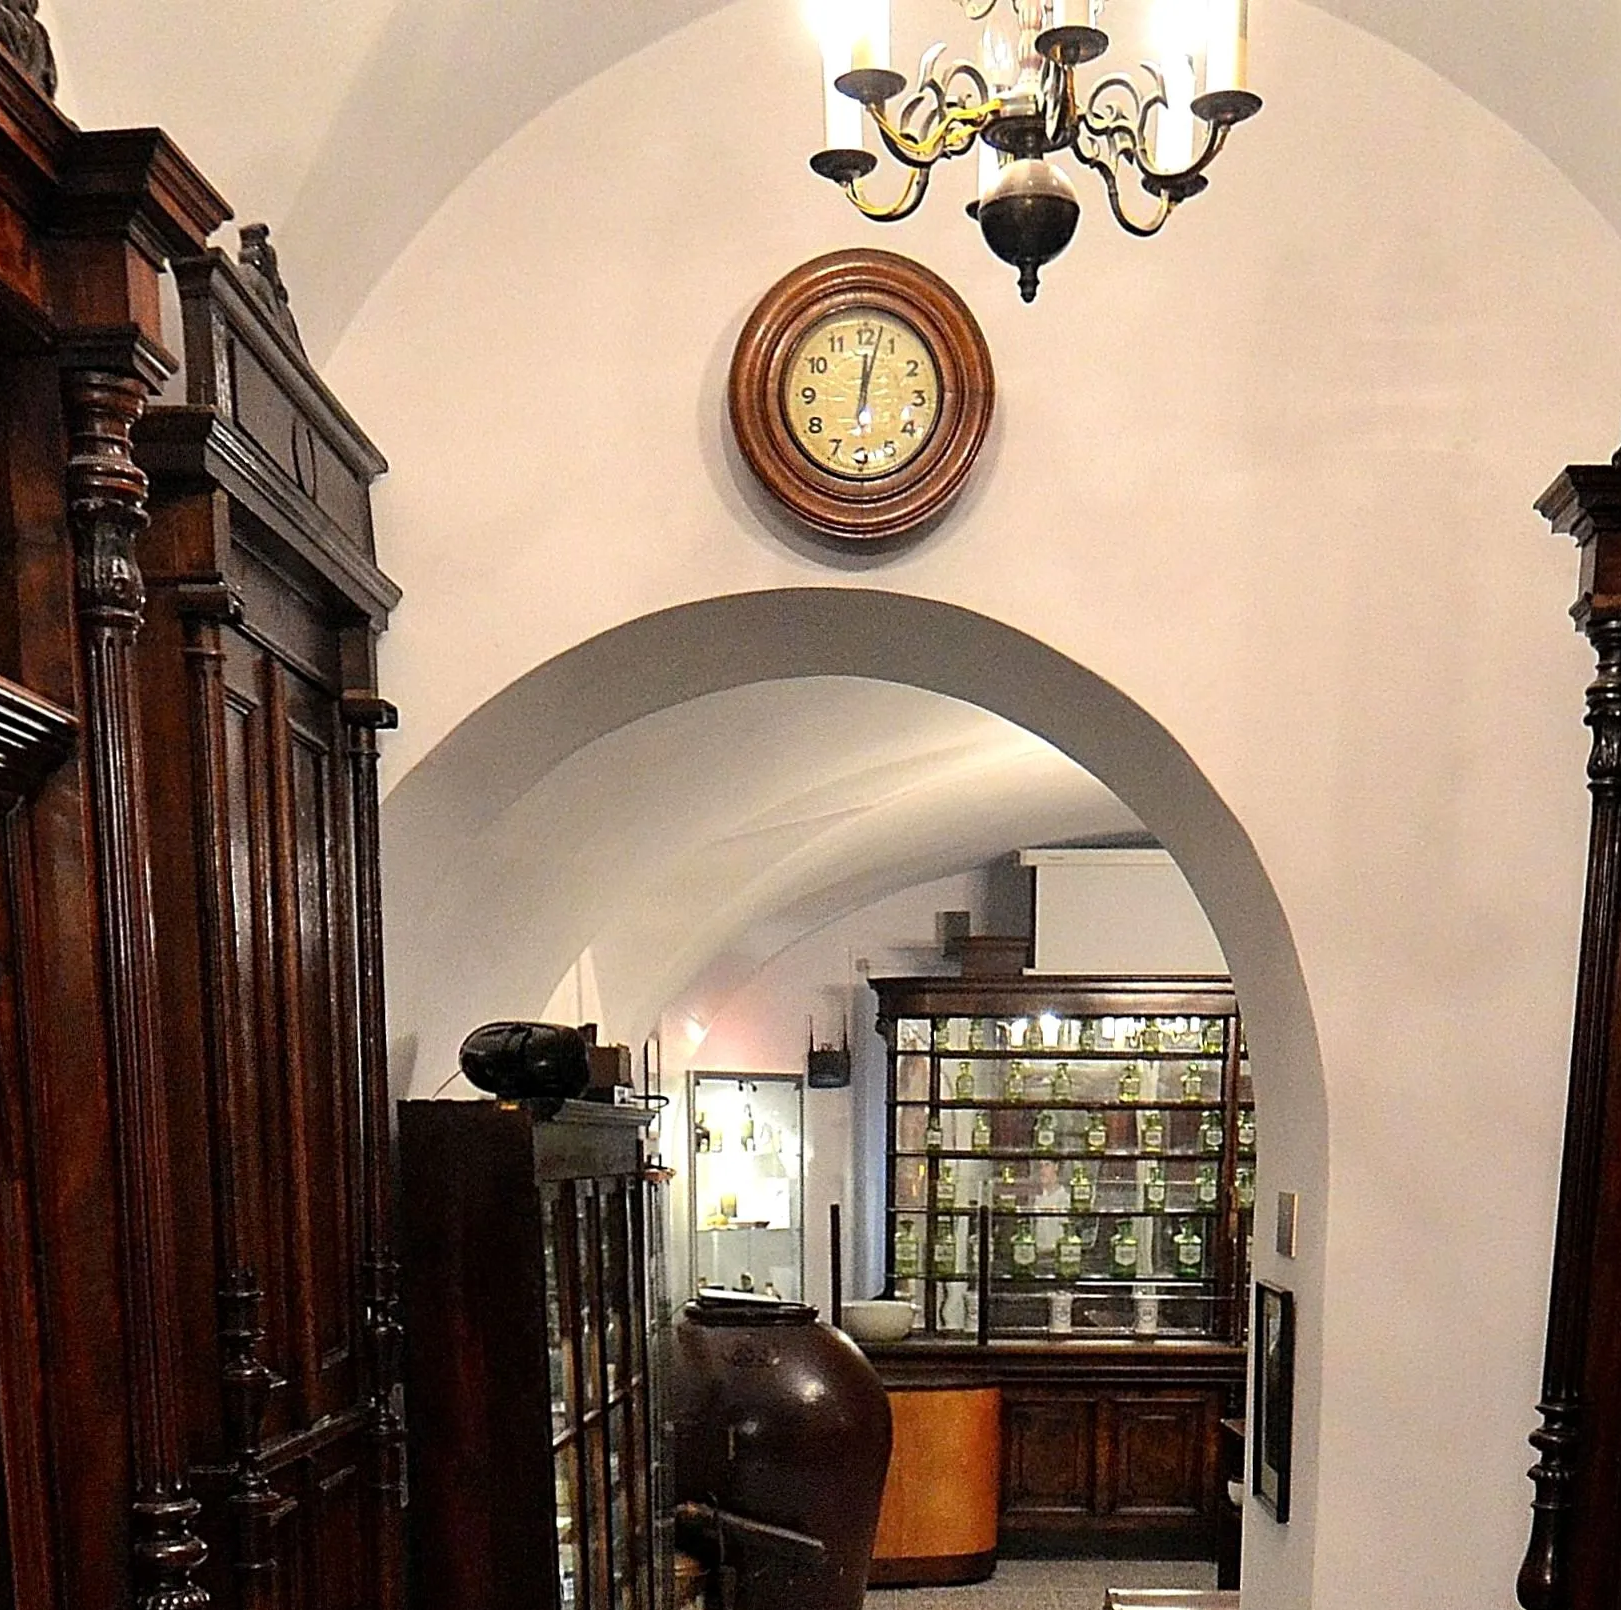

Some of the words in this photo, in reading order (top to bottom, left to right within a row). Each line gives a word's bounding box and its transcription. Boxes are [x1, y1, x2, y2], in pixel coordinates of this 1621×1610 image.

[828, 335, 844, 353] 11
[857, 328, 874, 346] 12
[888, 338, 895, 353] 1
[808, 357, 827, 374] 10
[906, 360, 918, 377] 2
[802, 388, 816, 404] 9
[912, 390, 926, 406] 3
[808, 417, 822, 434] 8
[901, 421, 916, 436] 4
[829, 440, 842, 456] 7
